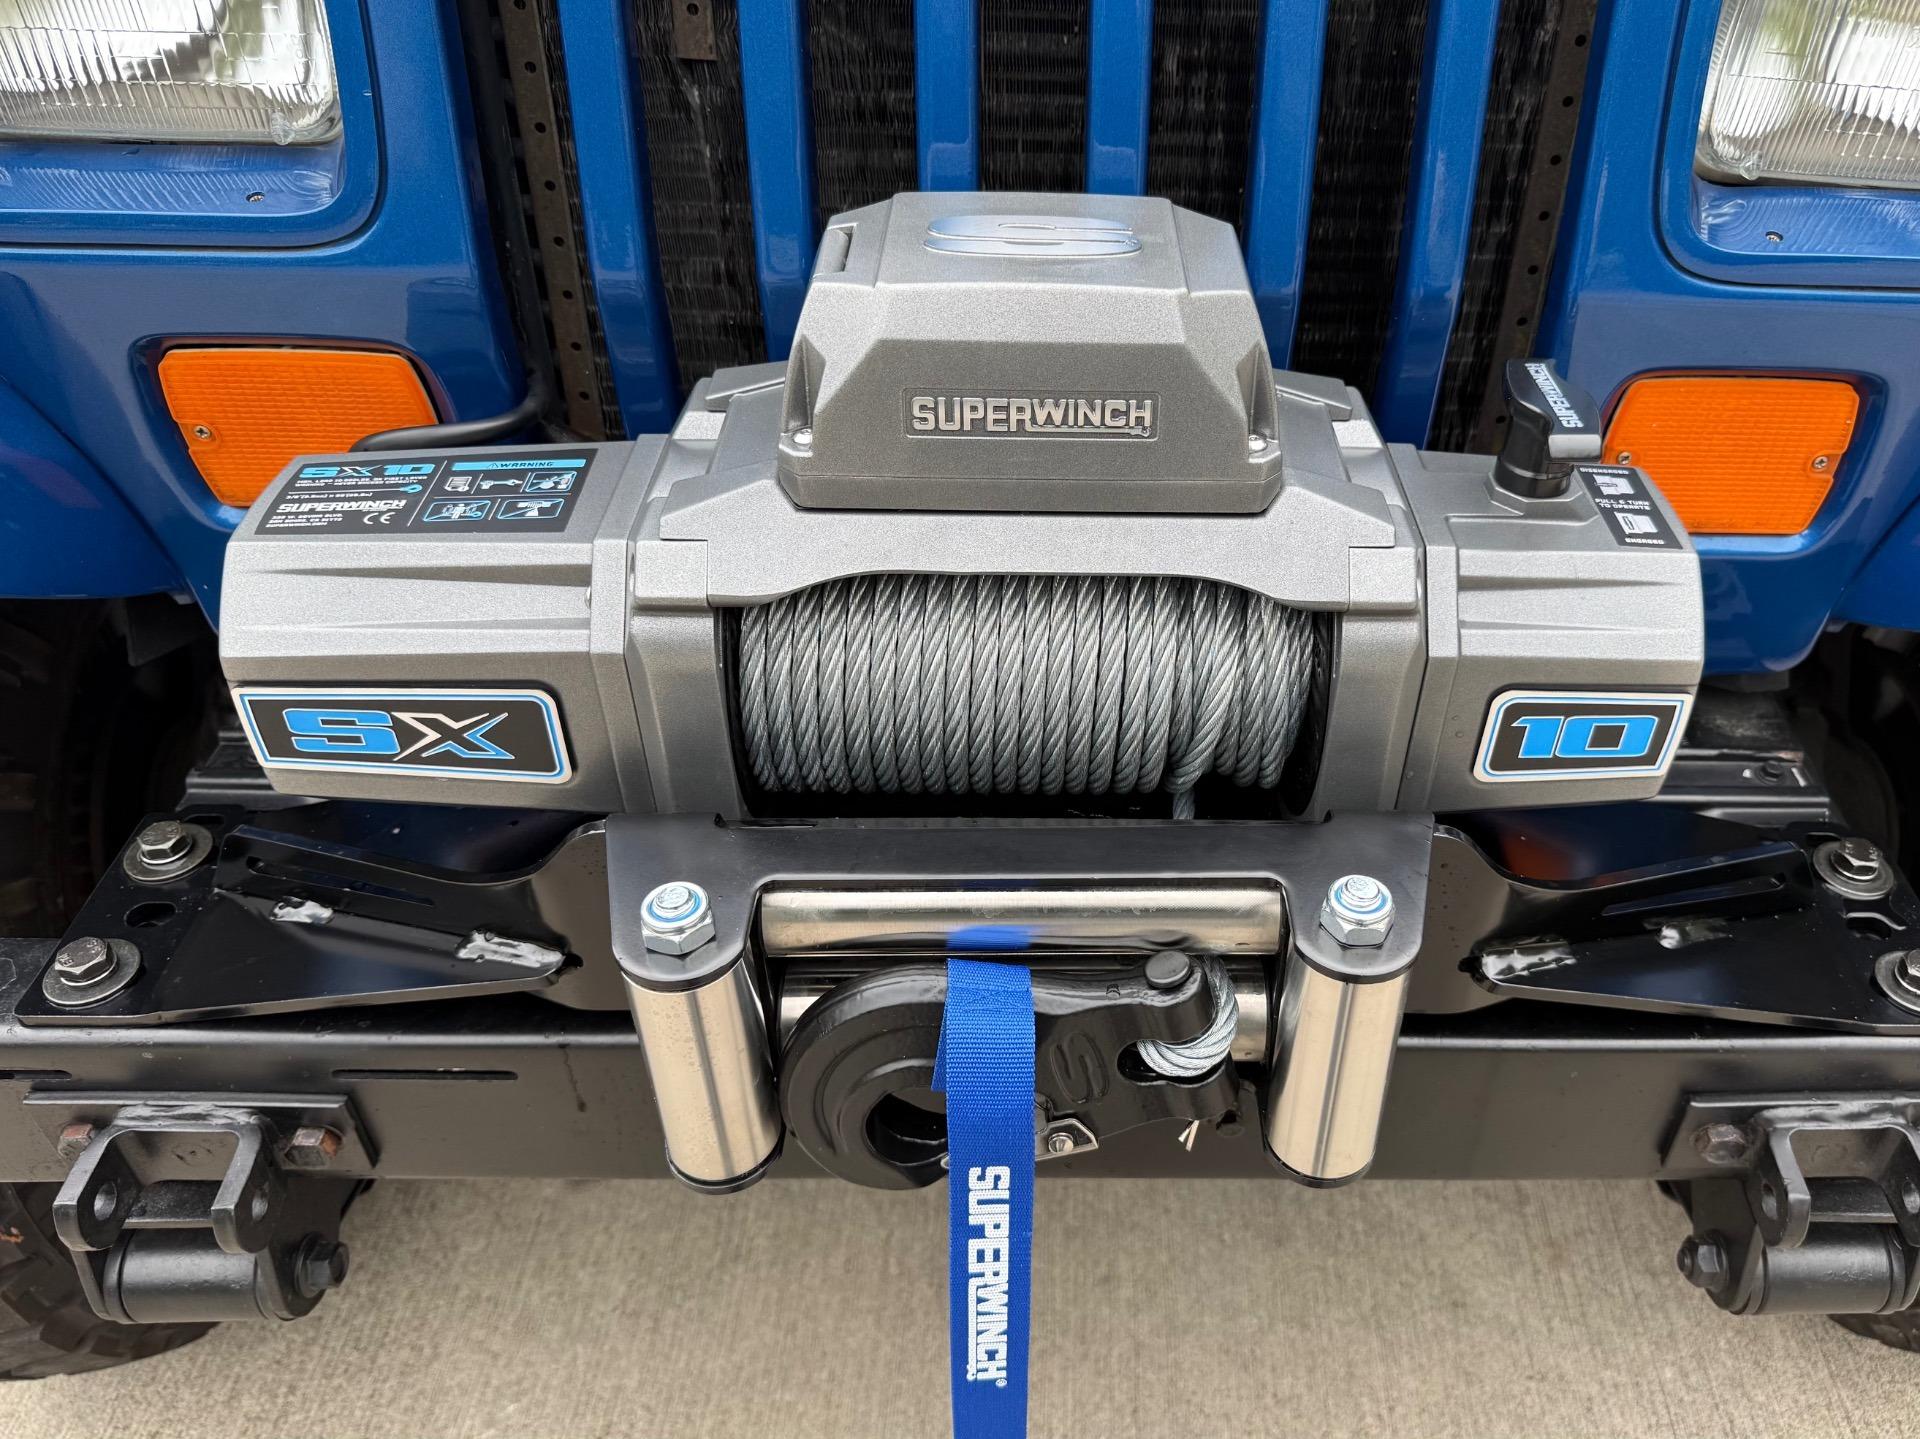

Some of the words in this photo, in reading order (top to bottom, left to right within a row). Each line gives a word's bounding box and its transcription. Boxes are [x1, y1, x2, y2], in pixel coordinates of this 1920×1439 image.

[1524, 363, 1584, 427] SUPERWINCH
[911, 396, 1153, 437] SUPERWINCH
[500, 461, 554, 469] WARNING
[276, 499, 408, 513] SUPERWINCH
[282, 708, 515, 761] SX
[1511, 714, 1659, 758] 10
